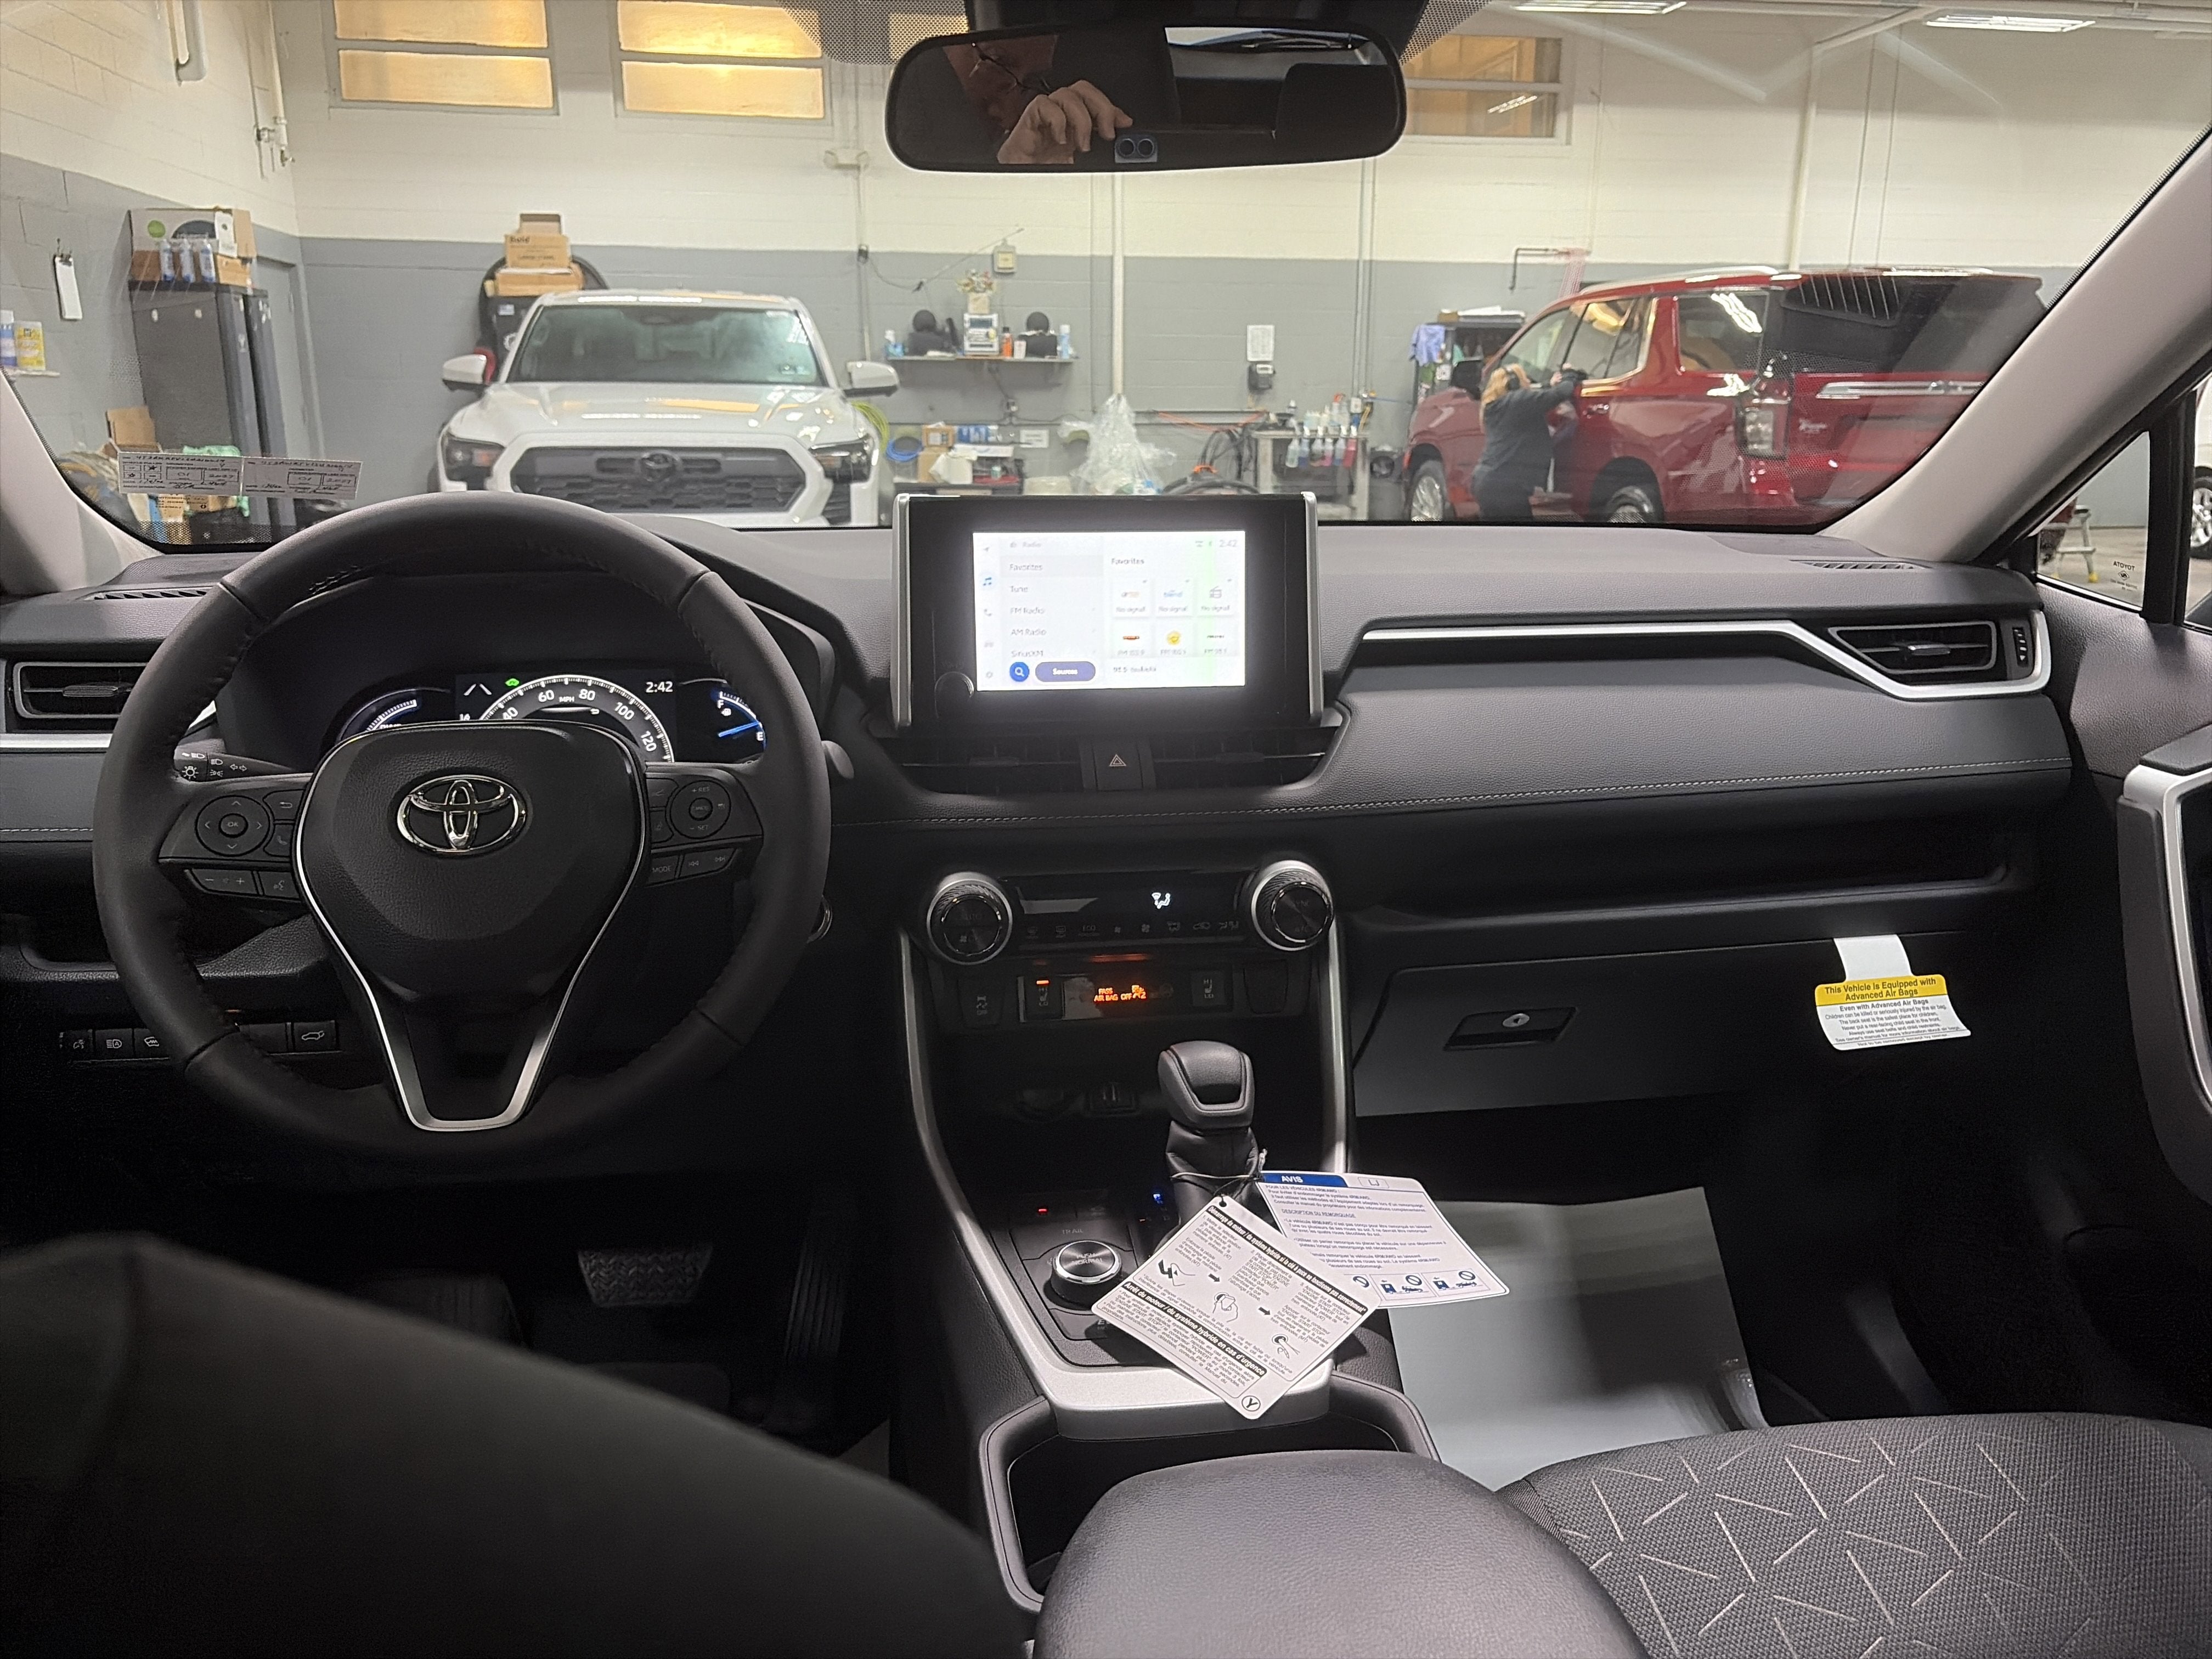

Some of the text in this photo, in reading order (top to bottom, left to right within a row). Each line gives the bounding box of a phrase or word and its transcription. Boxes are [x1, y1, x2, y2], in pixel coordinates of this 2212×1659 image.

[1052, 668, 1079, 676] Sources
[646, 681, 673, 693] 2:42
[538, 689, 555, 703] 60
[578, 689, 596, 701] 80
[716, 699, 725, 709] F
[503, 707, 518, 720] 40
[614, 701, 635, 721] 100
[640, 730, 657, 752] 120
[757, 731, 764, 741] E
[1825, 986, 1842, 994] This
[1843, 984, 1871, 992] Vehicle
[1882, 979, 1918, 991] Equipped
[1920, 977, 1936, 986] with
[1120, 992, 1132, 1001] OFF
[1846, 991, 1883, 1001] Advanced
[1898, 989, 1918, 997] Bags
[1871, 1001, 1901, 1009] Advanced
[1071, 1257, 1103, 1266] NORMAL
[1123, 1282, 1140, 1294] Arrêt
[1137, 1290, 1147, 1298] du
[1144, 1295, 1165, 1308] moteur
[1166, 1307, 1176, 1315] du
[1173, 1312, 1198, 1329] système
[1196, 1326, 1219, 1344] hybride
[1217, 1341, 1227, 1349] en
[1224, 1346, 1237, 1356] cas
[1235, 1353, 1265, 1375] d'urgence
[1248, 1398, 1258, 1410] Y
